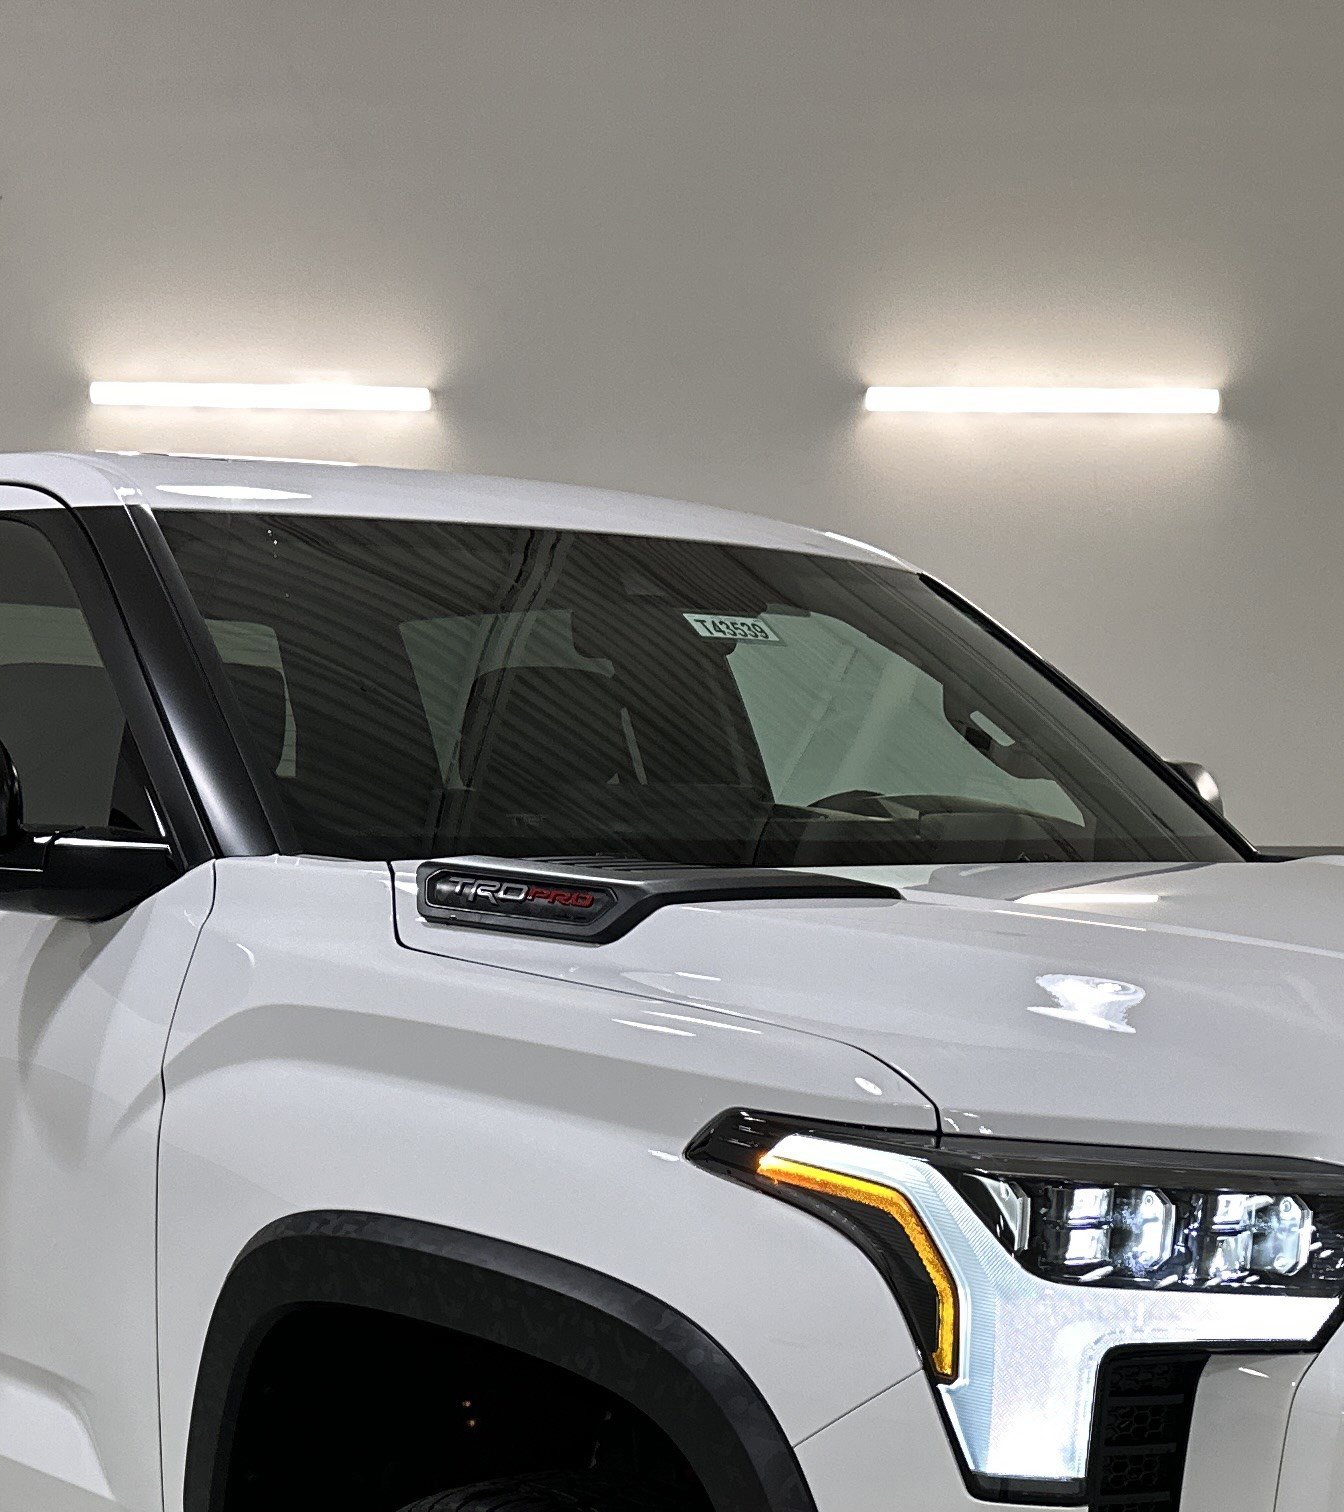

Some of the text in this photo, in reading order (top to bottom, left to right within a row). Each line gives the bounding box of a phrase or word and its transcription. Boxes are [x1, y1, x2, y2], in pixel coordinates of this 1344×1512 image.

[693, 618, 770, 640] T43539
[449, 877, 595, 908] TRD PRO
